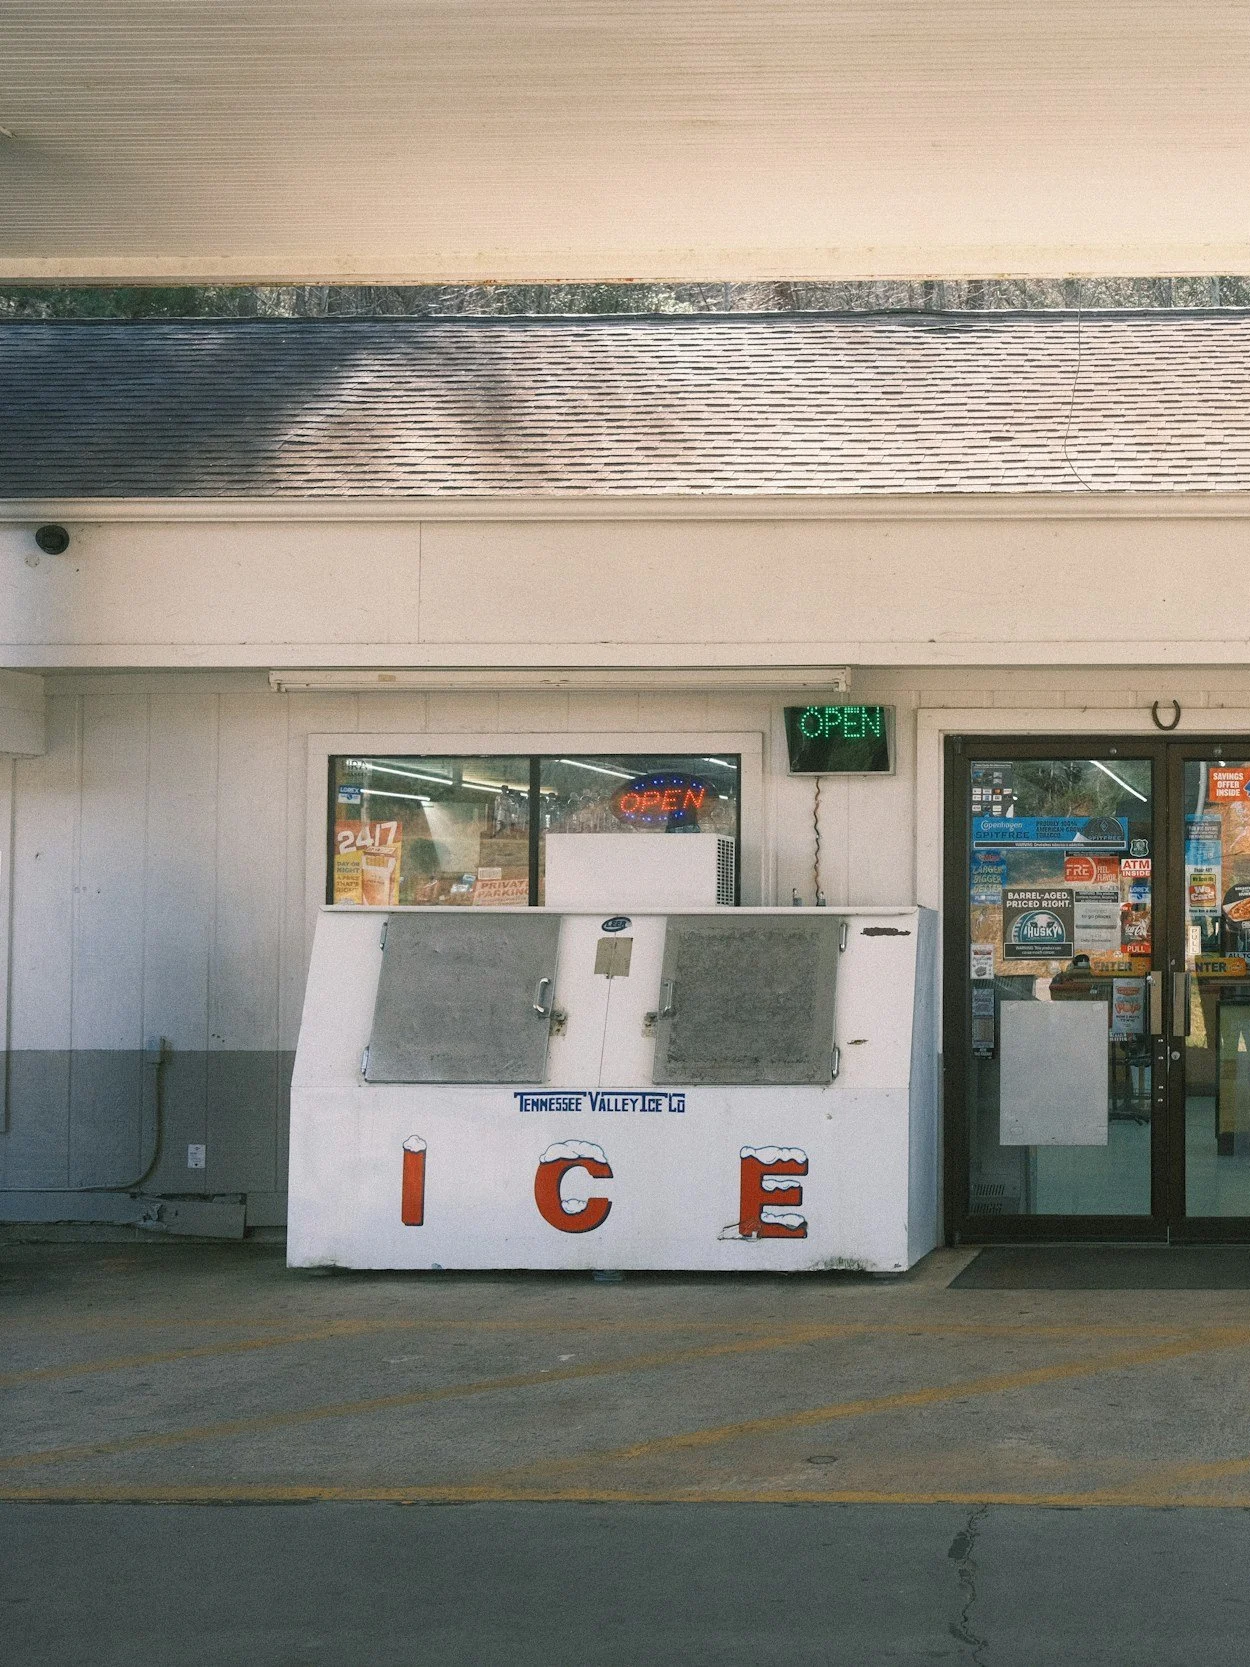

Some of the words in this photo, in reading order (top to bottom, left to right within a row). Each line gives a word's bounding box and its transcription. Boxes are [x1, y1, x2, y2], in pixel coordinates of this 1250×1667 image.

[800, 706, 881, 738] OPEN
[1213, 772, 1244, 780] SAVINGS
[1217, 780, 1240, 789] OFFER
[1216, 788, 1241, 797] INSIDE
[619, 787, 705, 813] OPEN
[980, 820, 1023, 832] Copenhagen
[1122, 860, 1150, 869] ATM
[1066, 864, 1090, 876] FRE
[480, 880, 529, 890] PRIVAT
[1007, 892, 1070, 900] BARREL-AGED.
[1006, 900, 1040, 908] PRICED
[1041, 900, 1072, 908] RIGHT.
[605, 919, 628, 928] LEER
[1027, 925, 1059, 938] HUSKY
[1127, 945, 1146, 953] PULL
[1195, 961, 1227, 973] NTER
[514, 1092, 587, 1112] TENNESSEE
[401, 1134, 809, 1239] ICE
